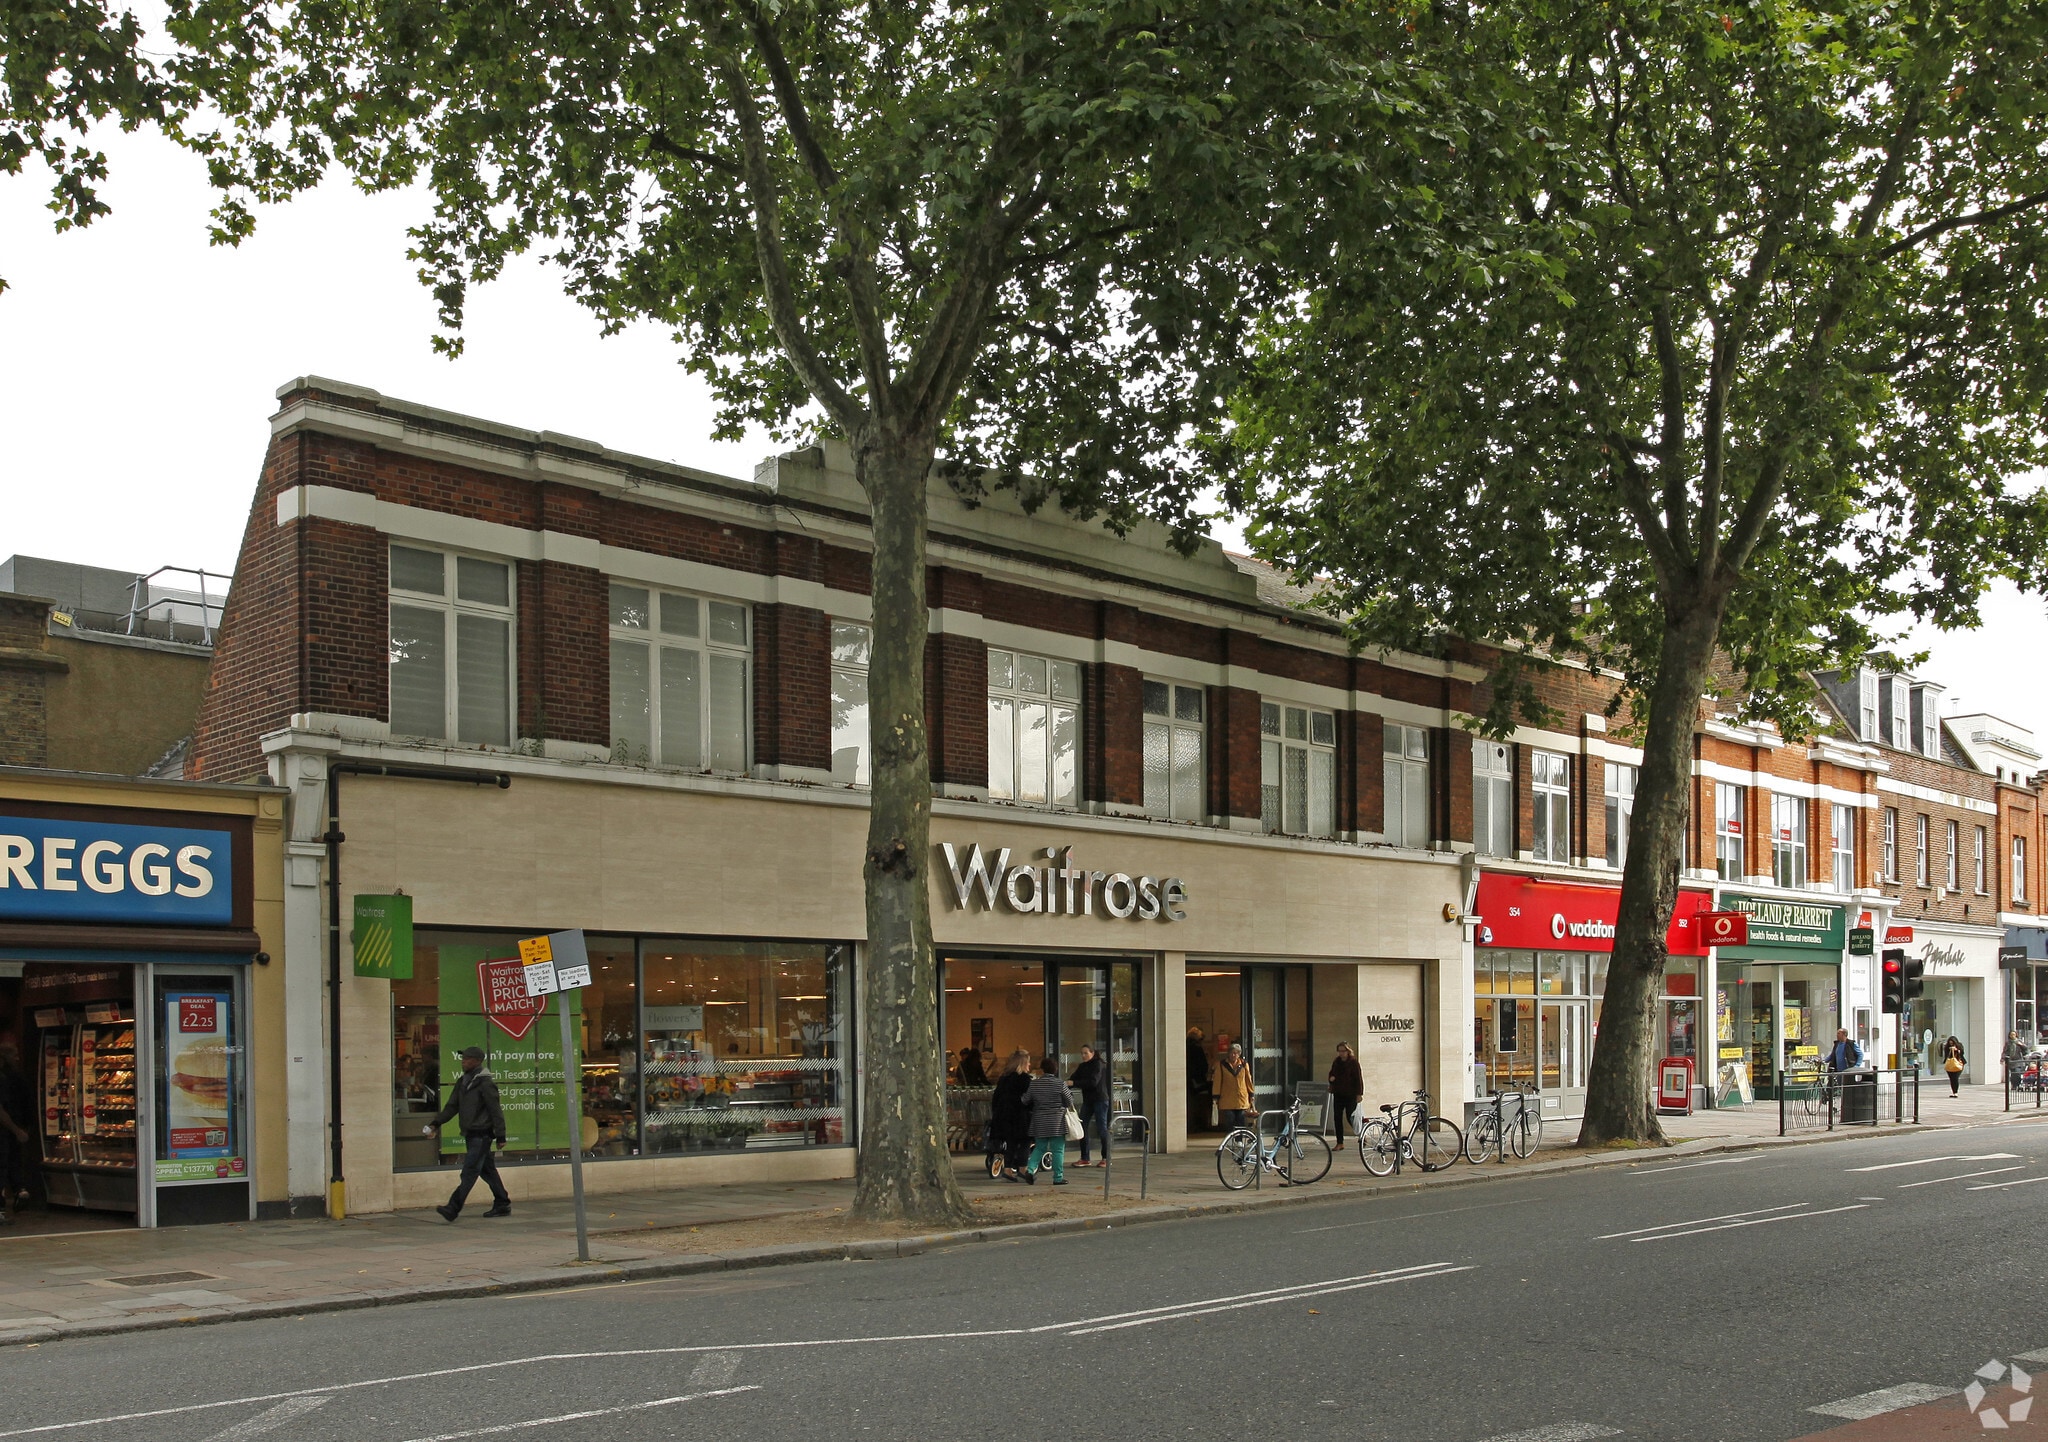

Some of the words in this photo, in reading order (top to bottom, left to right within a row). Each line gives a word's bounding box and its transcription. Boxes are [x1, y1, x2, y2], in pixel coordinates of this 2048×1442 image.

[937, 843, 1188, 921] Waitrose
[356, 906, 385, 918] Waitrose
[1509, 906, 1520, 917] 354
[1783, 904, 1792, 928] &
[1793, 908, 1833, 931] BARRETT
[1569, 919, 1616, 938] vodafon
[1679, 919, 1688, 928] 352
[1750, 930, 1765, 940] health
[1766, 931, 1779, 941] foods
[1780, 932, 1784, 941] &
[1785, 933, 1801, 943] natural
[1802, 934, 1822, 944] remedies
[490, 966, 524, 976] Waitros
[492, 975, 526, 988] BRAN
[493, 986, 528, 1001] PRIC
[495, 998, 534, 1013] MATCH
[183, 1012, 213, 1027] £2.25
[1367, 1013, 1415, 1030] Waitrose
[505, 1053, 525, 1063] pay
[503, 1069, 534, 1079] Tesco's
